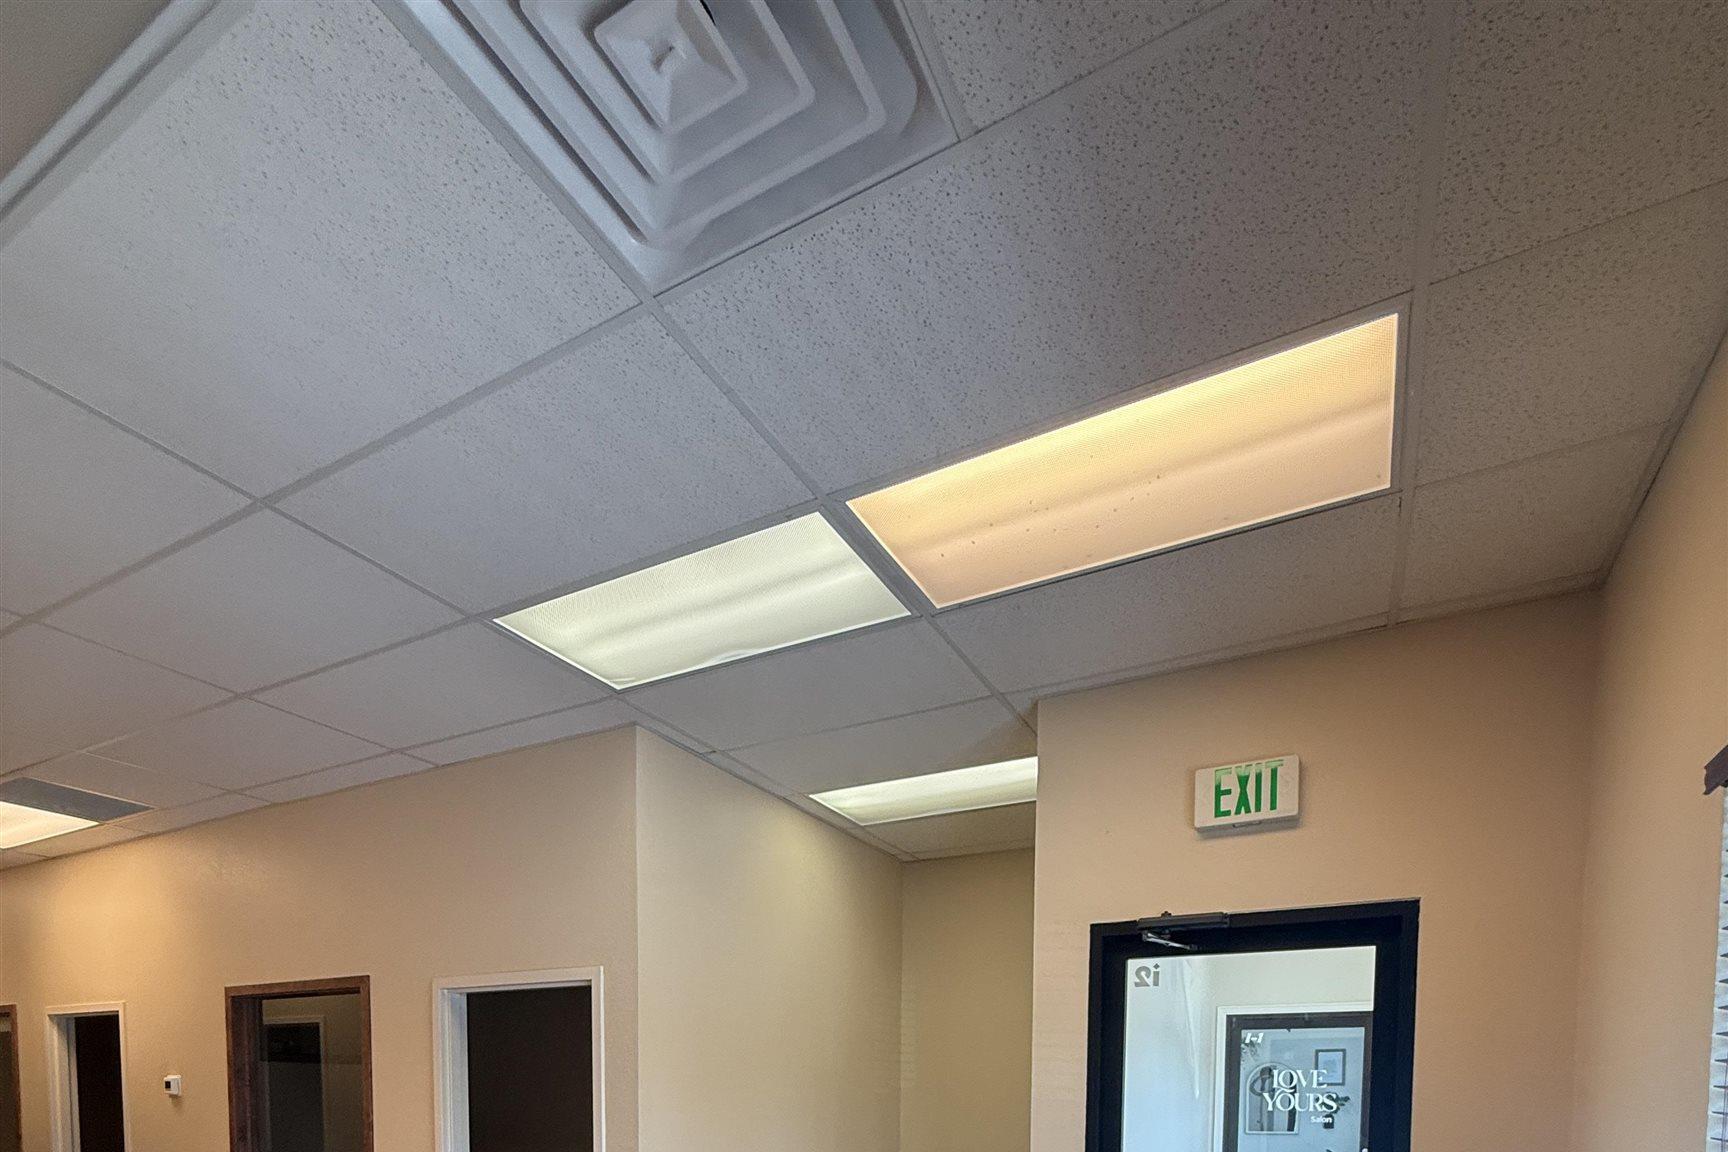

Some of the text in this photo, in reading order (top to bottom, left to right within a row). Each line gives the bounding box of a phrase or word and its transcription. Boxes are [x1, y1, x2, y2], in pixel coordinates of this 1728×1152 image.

[1214, 759, 1284, 818] EXIT
[1272, 1069, 1328, 1092] LOVE
[1262, 1091, 1338, 1112] YOURS
[1310, 1115, 1333, 1124] Salon
